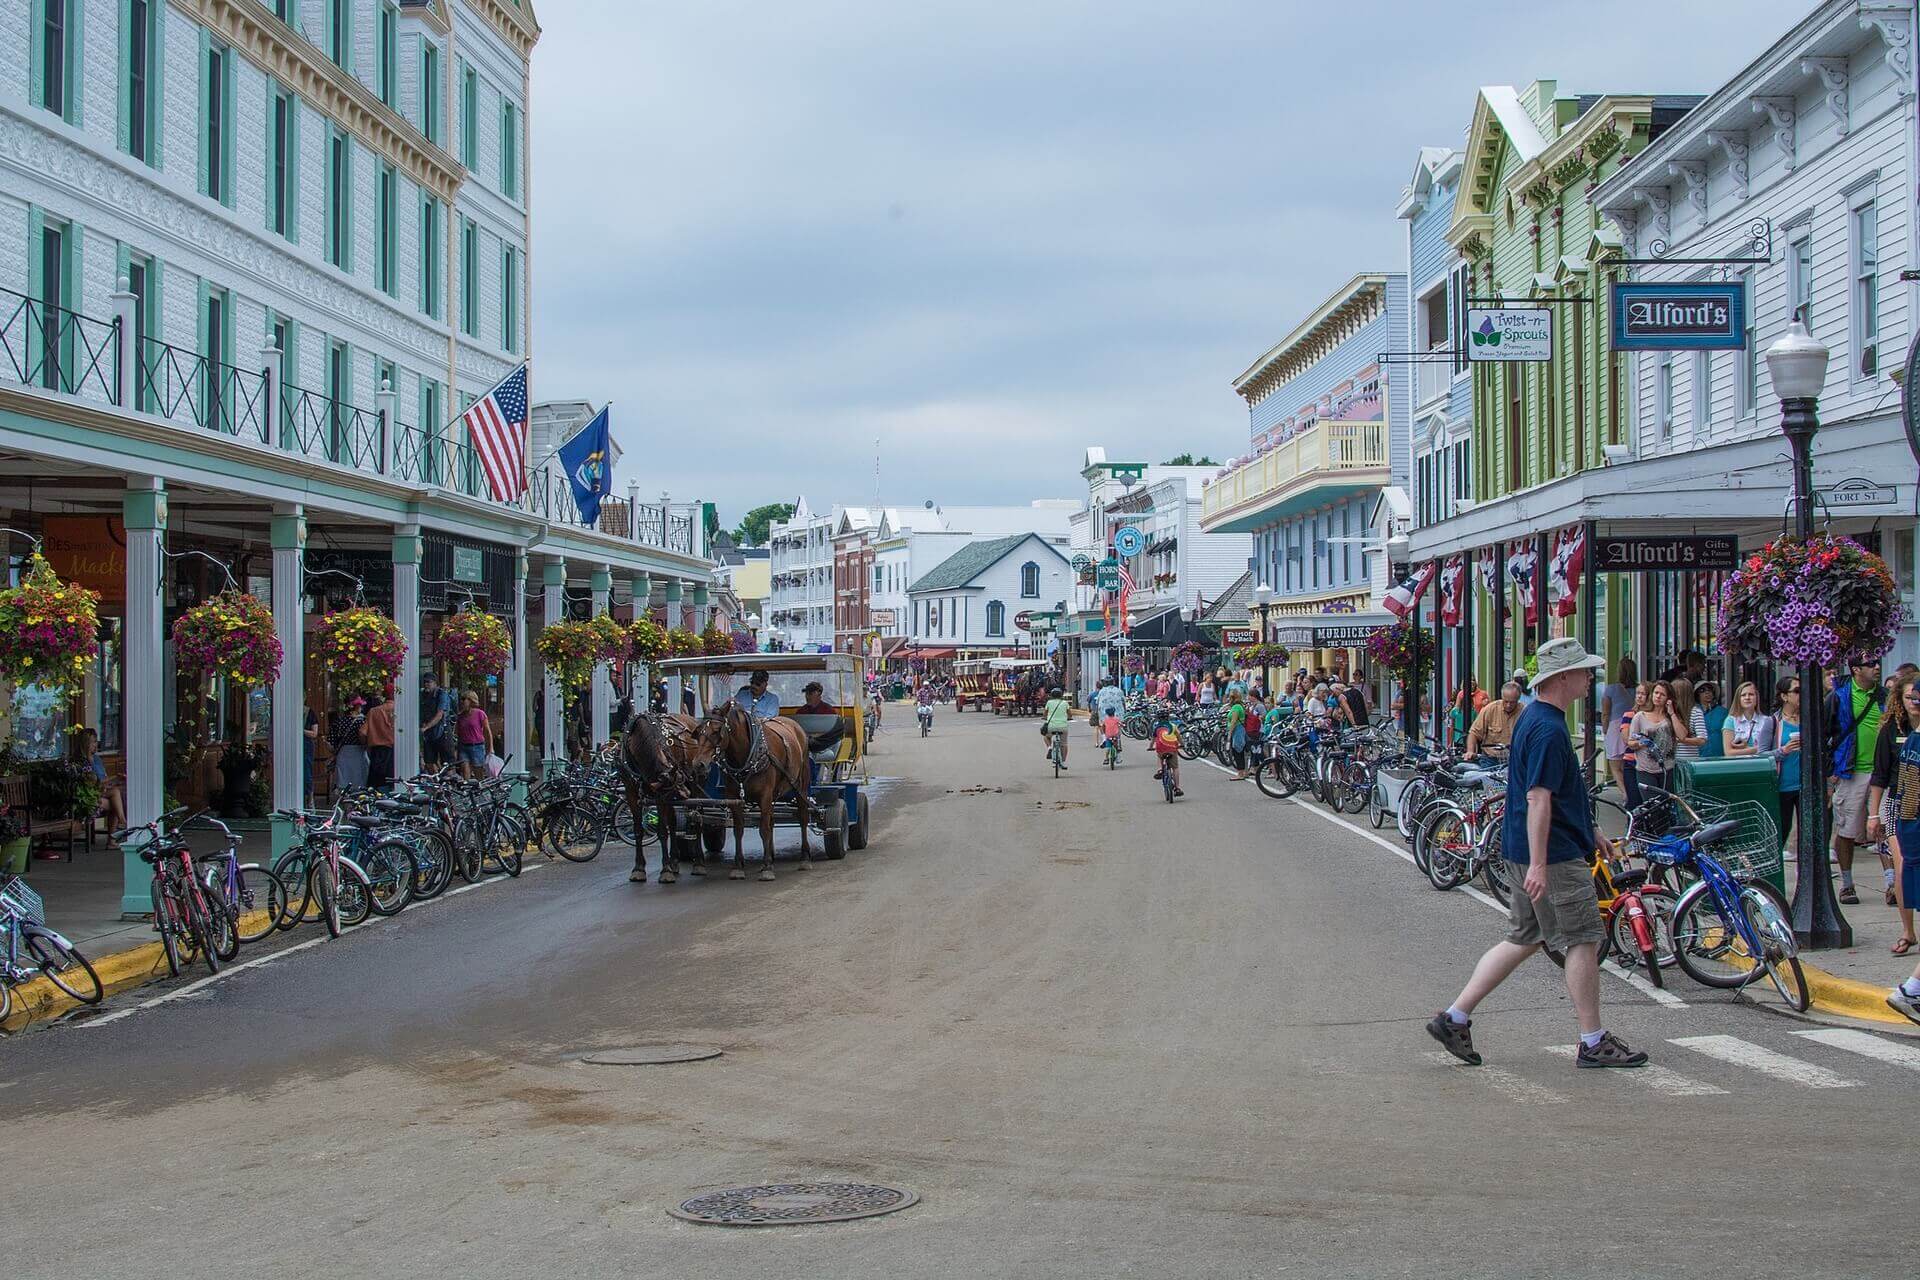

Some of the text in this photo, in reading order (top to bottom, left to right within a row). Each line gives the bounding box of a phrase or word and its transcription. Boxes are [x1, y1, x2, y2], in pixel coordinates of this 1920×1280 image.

[1495, 312, 1526, 327] Twist
[1629, 302, 1728, 326] Alford's
[1503, 327, 1549, 343] Sprouts
[1833, 492, 1880, 502] FORT ST.
[1705, 540, 1730, 549] Gifts
[1607, 541, 1695, 564] Alford's
[1317, 627, 1371, 639] MURDICKS
